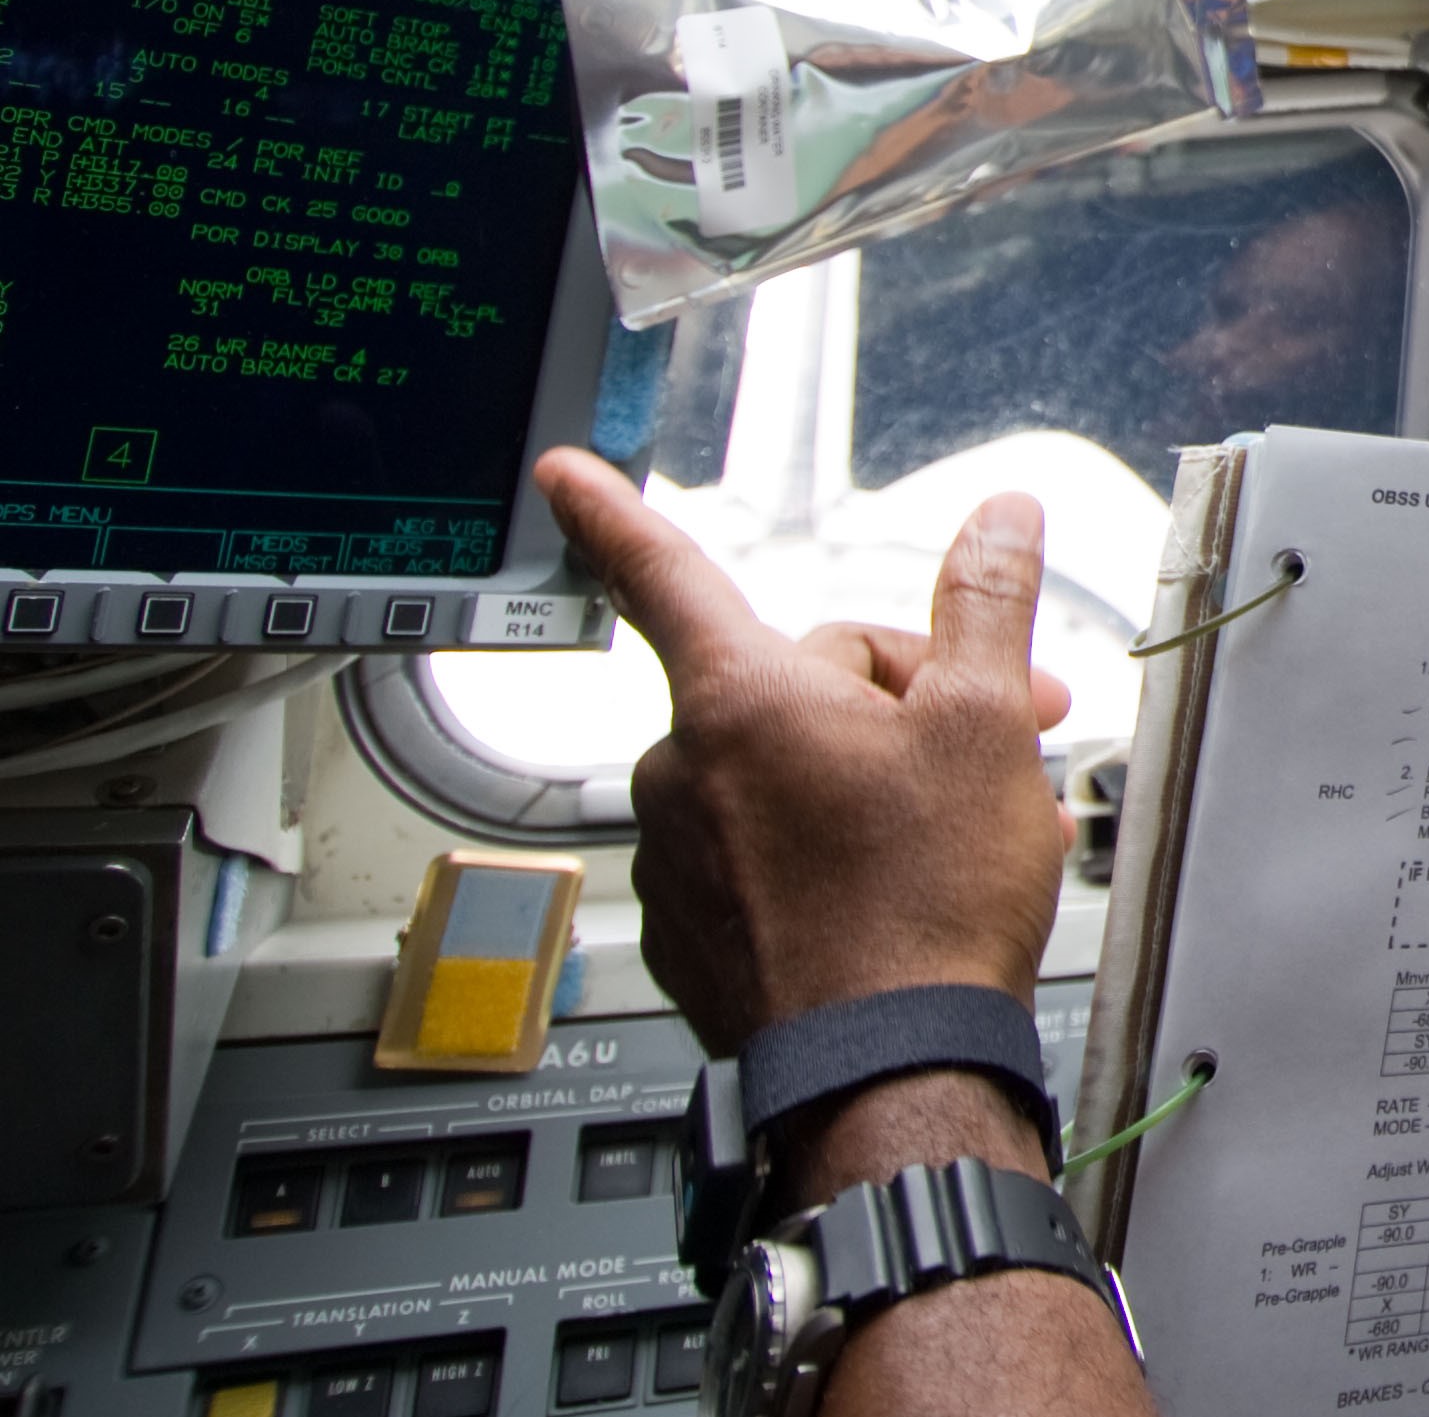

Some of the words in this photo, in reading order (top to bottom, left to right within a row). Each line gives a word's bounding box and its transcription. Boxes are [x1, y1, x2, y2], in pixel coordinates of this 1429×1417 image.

[193, 3, 225, 22] ON
[319, 3, 379, 27] SOFT
[392, 16, 451, 37] STOP
[314, 22, 375, 45] AUTO
[387, 34, 460, 58] BRAKE
[132, 49, 197, 72] AUTO
[211, 60, 289, 86] MODES
[310, 39, 357, 60] POS
[368, 49, 415, 70] ENC
[427, 56, 455, 75] CK
[381, 68, 438, 91] CNTL
[0, 106, 52, 129] OPR
[67, 115, 117, 135] CMD
[131, 123, 213, 149] MODES
[257, 140, 305, 160] POR
[318, 147, 366, 167] REF
[207, 153, 239, 170] 24
[253, 157, 283, 176] PL
[302, 163, 361, 185] INIT
[376, 172, 403, 191] ID
[200, 188, 247, 208] CMD
[262, 196, 291, 214] CK
[305, 200, 339, 218] 25
[351, 205, 411, 226] GOOD
[191, 224, 240, 245] POR
[253, 231, 361, 257] DISPLAY
[373, 243, 403, 260] 30
[417, 247, 460, 267] ORB
[245, 267, 291, 286] ORB
[306, 272, 337, 290] LD
[351, 277, 395, 295] CMD
[408, 283, 456, 300] REF
[179, 279, 243, 300] NORM
[271, 287, 394, 314] FLY-CAMR
[420, 300, 504, 323] FLY-PL
[167, 334, 200, 351] 26
[216, 338, 248, 357] WR
[261, 342, 337, 362] RANGE
[351, 348, 367, 365] 4
[163, 354, 228, 373] AUTO
[240, 359, 318, 380] BRAKE
[333, 366, 363, 382] CK
[376, 369, 409, 385] 27
[107, 441, 131, 468] 4
[1371, 488, 1420, 508] OBSS
[48, 506, 112, 523] MENU
[505, 601, 554, 617] MNC
[505, 622, 545, 638] R14
[1401, 765, 1414, 780] 2.
[1318, 785, 1356, 799] RHC
[1408, 867, 1424, 882] IF
[537, 1040, 619, 1071] A6U
[487, 1091, 579, 1112] ORBITAL
[589, 1084, 634, 1103] DAP
[1376, 1097, 1420, 1115] RATE
[306, 1124, 370, 1143] SELECT
[1373, 1118, 1421, 1136] MODE
[467, 1164, 501, 1180] AUTO
[1366, 1162, 1413, 1181] Adjust
[448, 1265, 548, 1293] MANUAL
[556, 1257, 627, 1280] MODE
[292, 1297, 432, 1328] TRANSLATION
[581, 1291, 627, 1312] ROLL
[432, 1362, 467, 1380] HIGH
[472, 1360, 484, 1377] Z
[327, 1377, 359, 1396] LOW
[364, 1374, 375, 1391] Z
[1337, 1385, 1403, 1409] BRAKES
